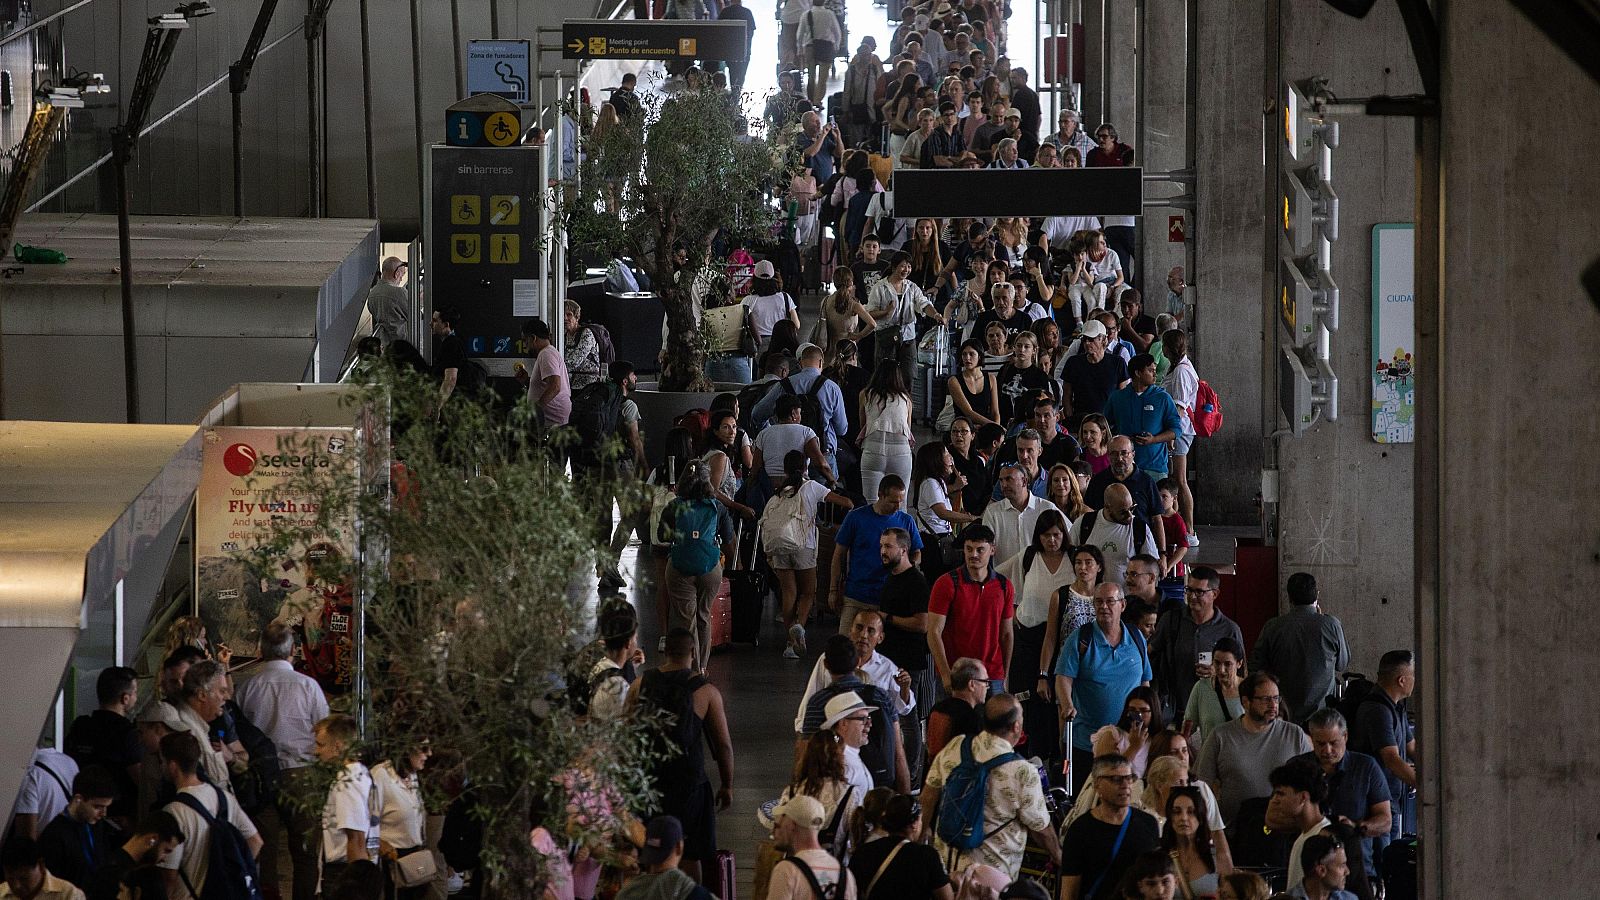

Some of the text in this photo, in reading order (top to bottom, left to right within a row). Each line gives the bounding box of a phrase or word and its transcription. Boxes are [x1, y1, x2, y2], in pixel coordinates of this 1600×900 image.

[609, 38, 649, 47] Meeting point
[609, 46, 630, 54] Punto
[631, 46, 640, 54] de
[457, 164, 514, 175] sin barreras
[230, 488, 250, 496] Your
[228, 500, 255, 517] Fly
[300, 503, 321, 513] us
[232, 518, 251, 526] And
[253, 518, 276, 527] tast
